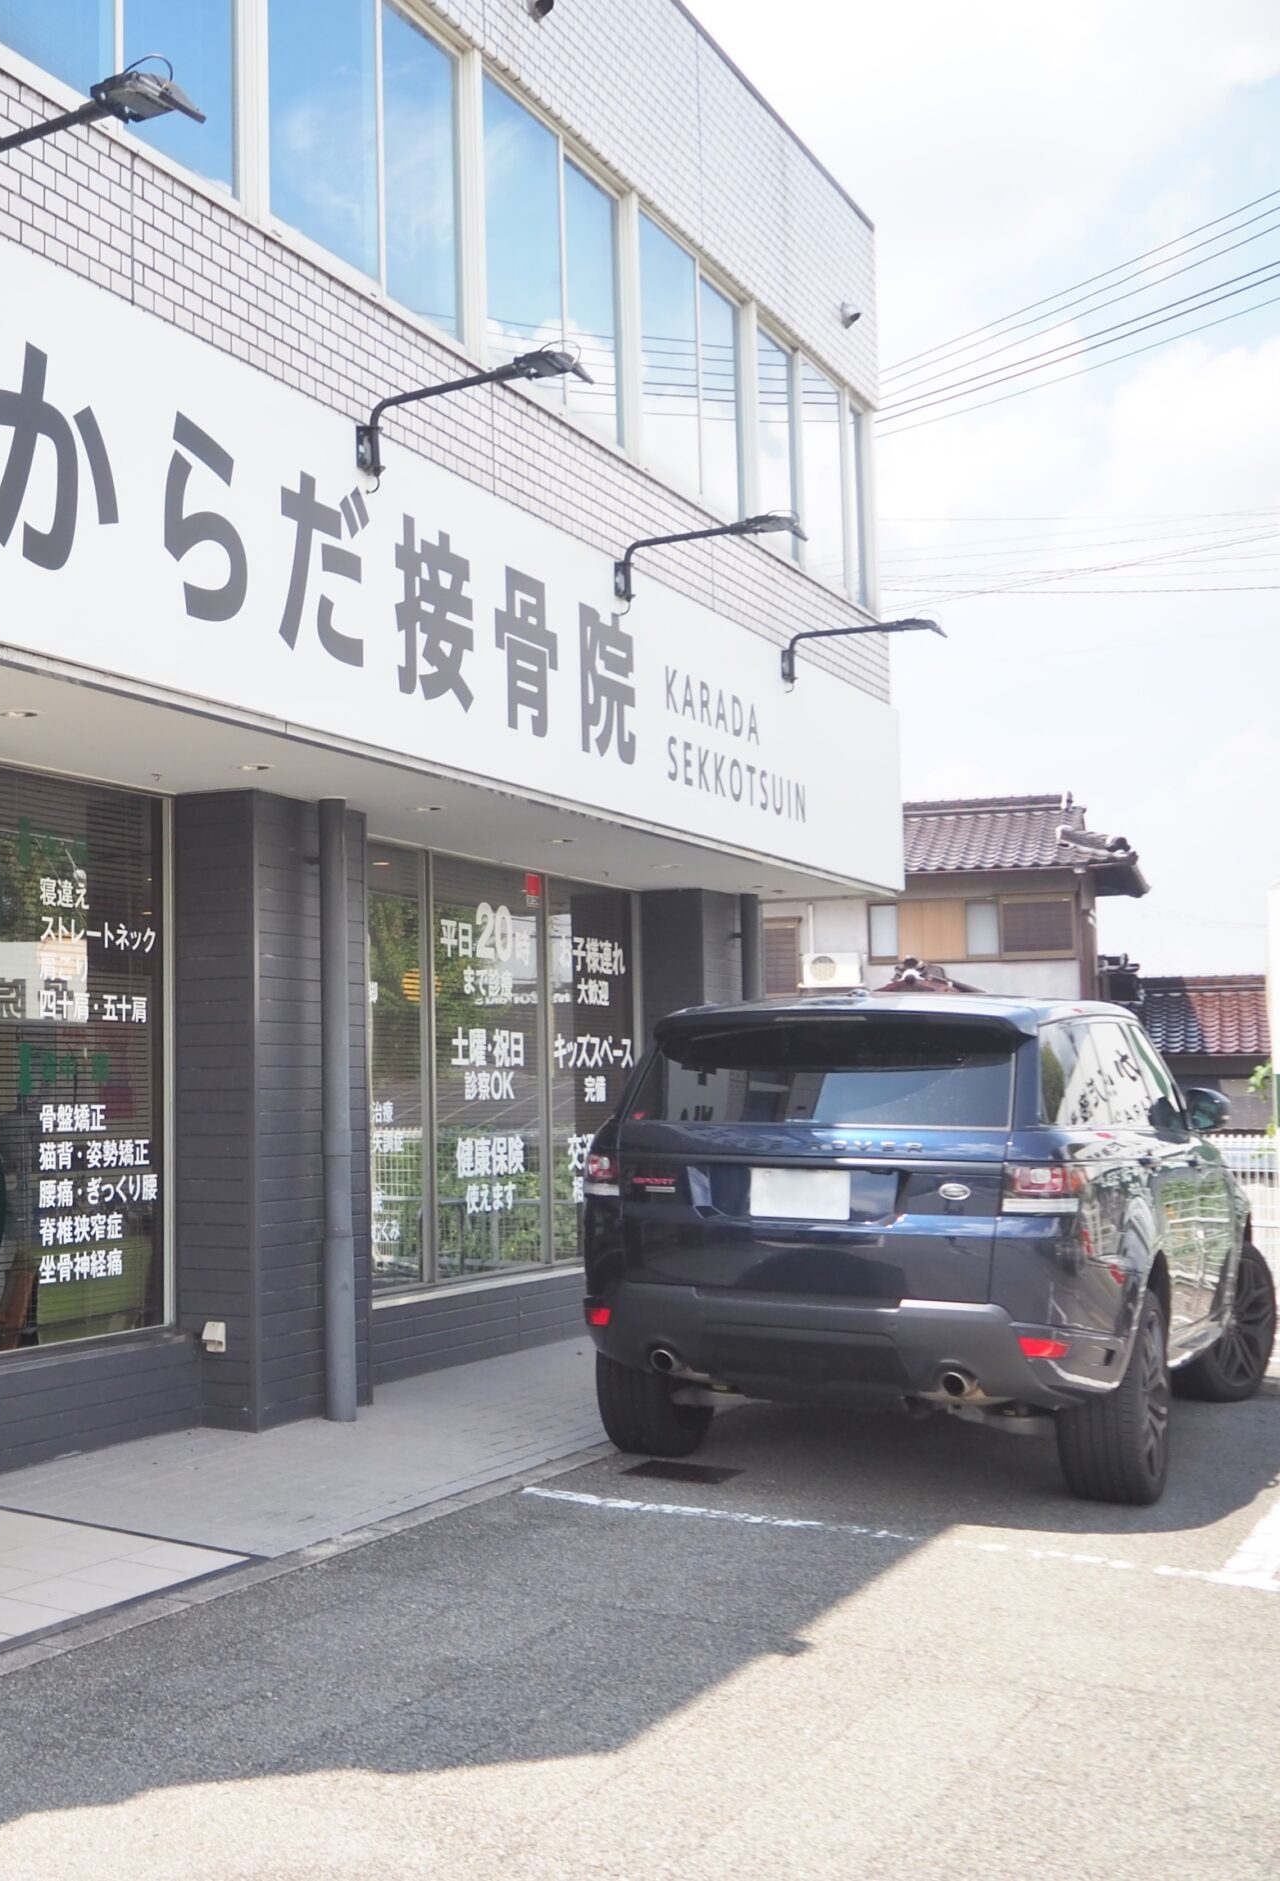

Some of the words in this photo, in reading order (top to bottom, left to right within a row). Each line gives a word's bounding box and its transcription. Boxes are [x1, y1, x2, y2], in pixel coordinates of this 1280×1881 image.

[665, 665, 760, 746] KARADA
[667, 736, 807, 824] SEKKOTSUIN
[39, 877, 90, 909] 寝違え
[40, 916, 156, 953] ストレートネック
[440, 902, 531, 966] 平日20時
[39, 955, 89, 982] 肩こり
[558, 936, 626, 975] お子様連れ
[39, 990, 148, 1024] 四十肩・五十肩
[577, 977, 609, 1006] 大歓迎
[451, 1026, 525, 1067] 土曜・祝日
[554, 1033, 633, 1069] キッズスペース
[464, 1071, 515, 1100] 診察OK
[584, 1075, 607, 1102] 完備
[39, 1104, 106, 1133] 骨盤矯正
[39, 1139, 150, 1171] 猫背・姿勢矯正
[456, 1136, 525, 1179] 健康保険
[810, 1140, 923, 1153] ROVER
[39, 1174, 158, 1208] 腰痛・ぎっくり腰
[465, 1181, 516, 1214] 使えます
[39, 1212, 123, 1246] 脊椎狭窄症
[39, 1248, 122, 1285] 坐骨神経痛
